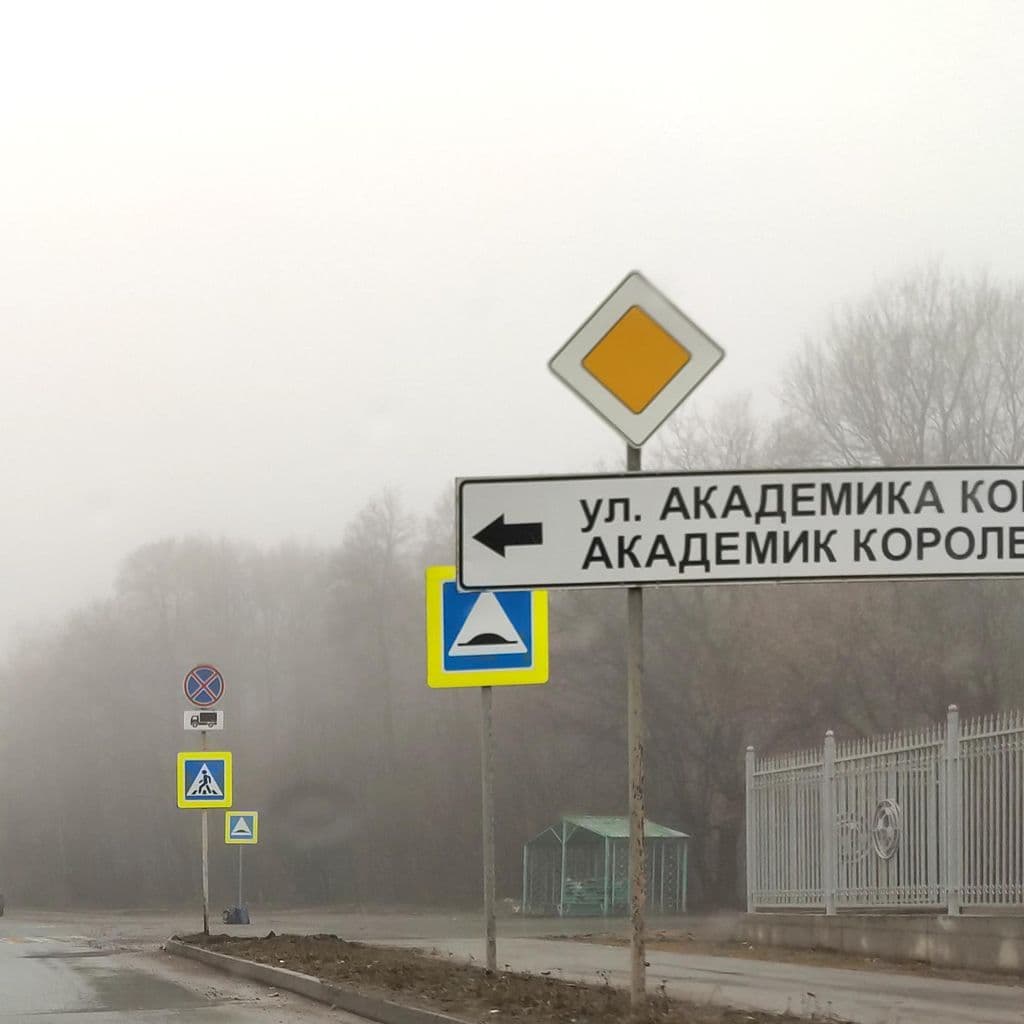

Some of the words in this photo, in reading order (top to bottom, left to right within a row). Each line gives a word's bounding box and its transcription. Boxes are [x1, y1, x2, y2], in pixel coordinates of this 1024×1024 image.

[580, 498, 641, 533] ул.
[659, 480, 945, 525] АКАДЕМИКА
[961, 479, 1024, 513] КО
[581, 529, 838, 574] АКАДЕМИК
[853, 526, 1024, 562] КОРОЛЕ
